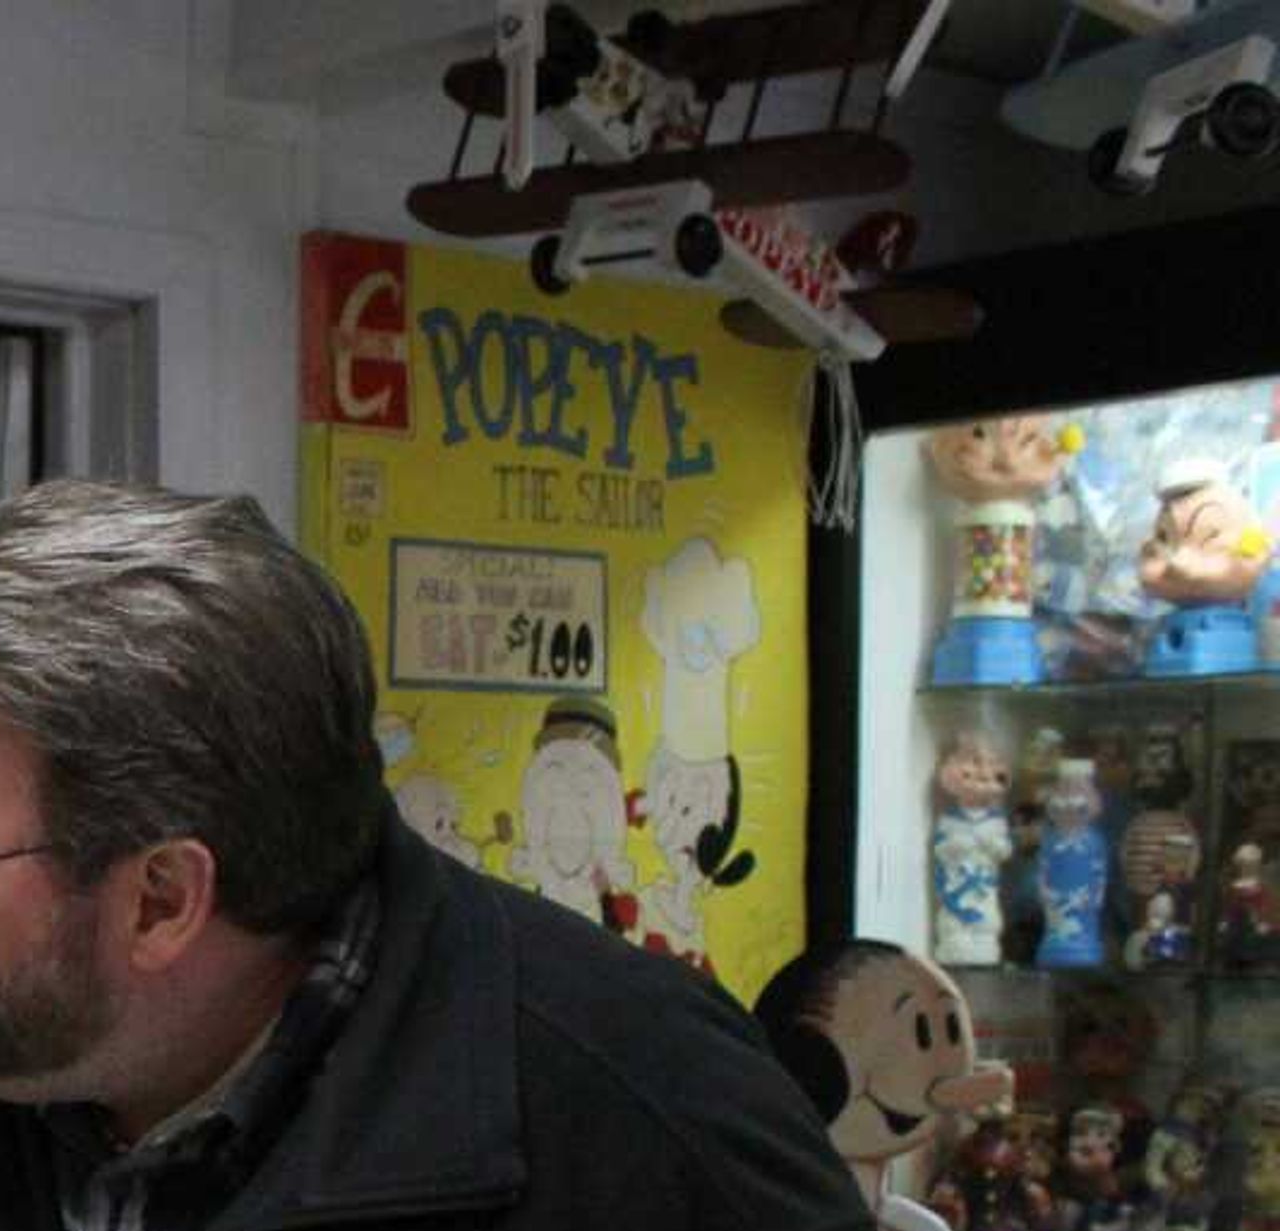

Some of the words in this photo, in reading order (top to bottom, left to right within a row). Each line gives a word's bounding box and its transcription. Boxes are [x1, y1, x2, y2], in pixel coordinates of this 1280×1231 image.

[417, 306, 715, 480] POPEYE
[493, 464, 561, 525] THE
[575, 472, 666, 536] SAILOR
[505, 614, 594, 679] $1.00
